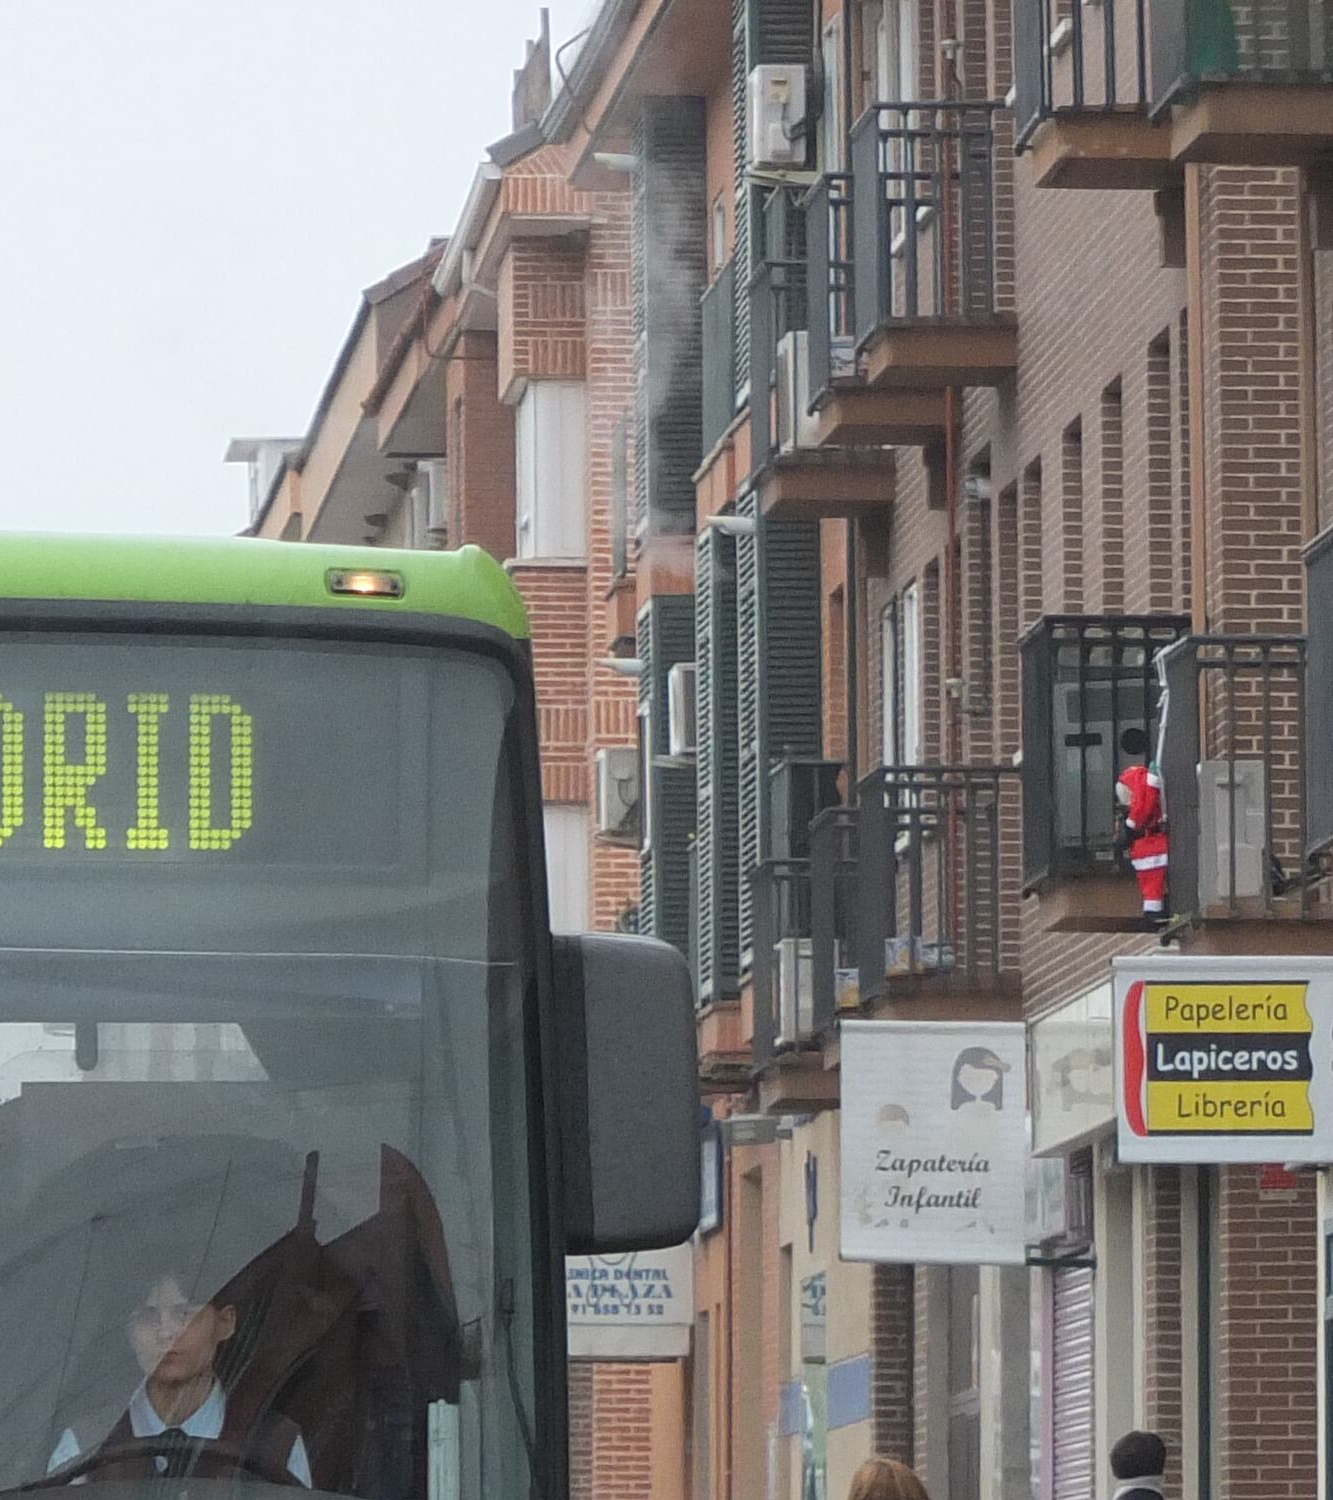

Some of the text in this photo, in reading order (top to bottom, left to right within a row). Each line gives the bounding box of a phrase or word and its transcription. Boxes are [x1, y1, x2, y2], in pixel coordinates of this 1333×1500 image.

[1165, 994, 1288, 1029] Papelería
[1156, 1042, 1298, 1079] Lapiceros
[1177, 1091, 1286, 1118] Librería
[875, 1149, 990, 1178] Zapatería
[884, 1185, 981, 1214] Infantil
